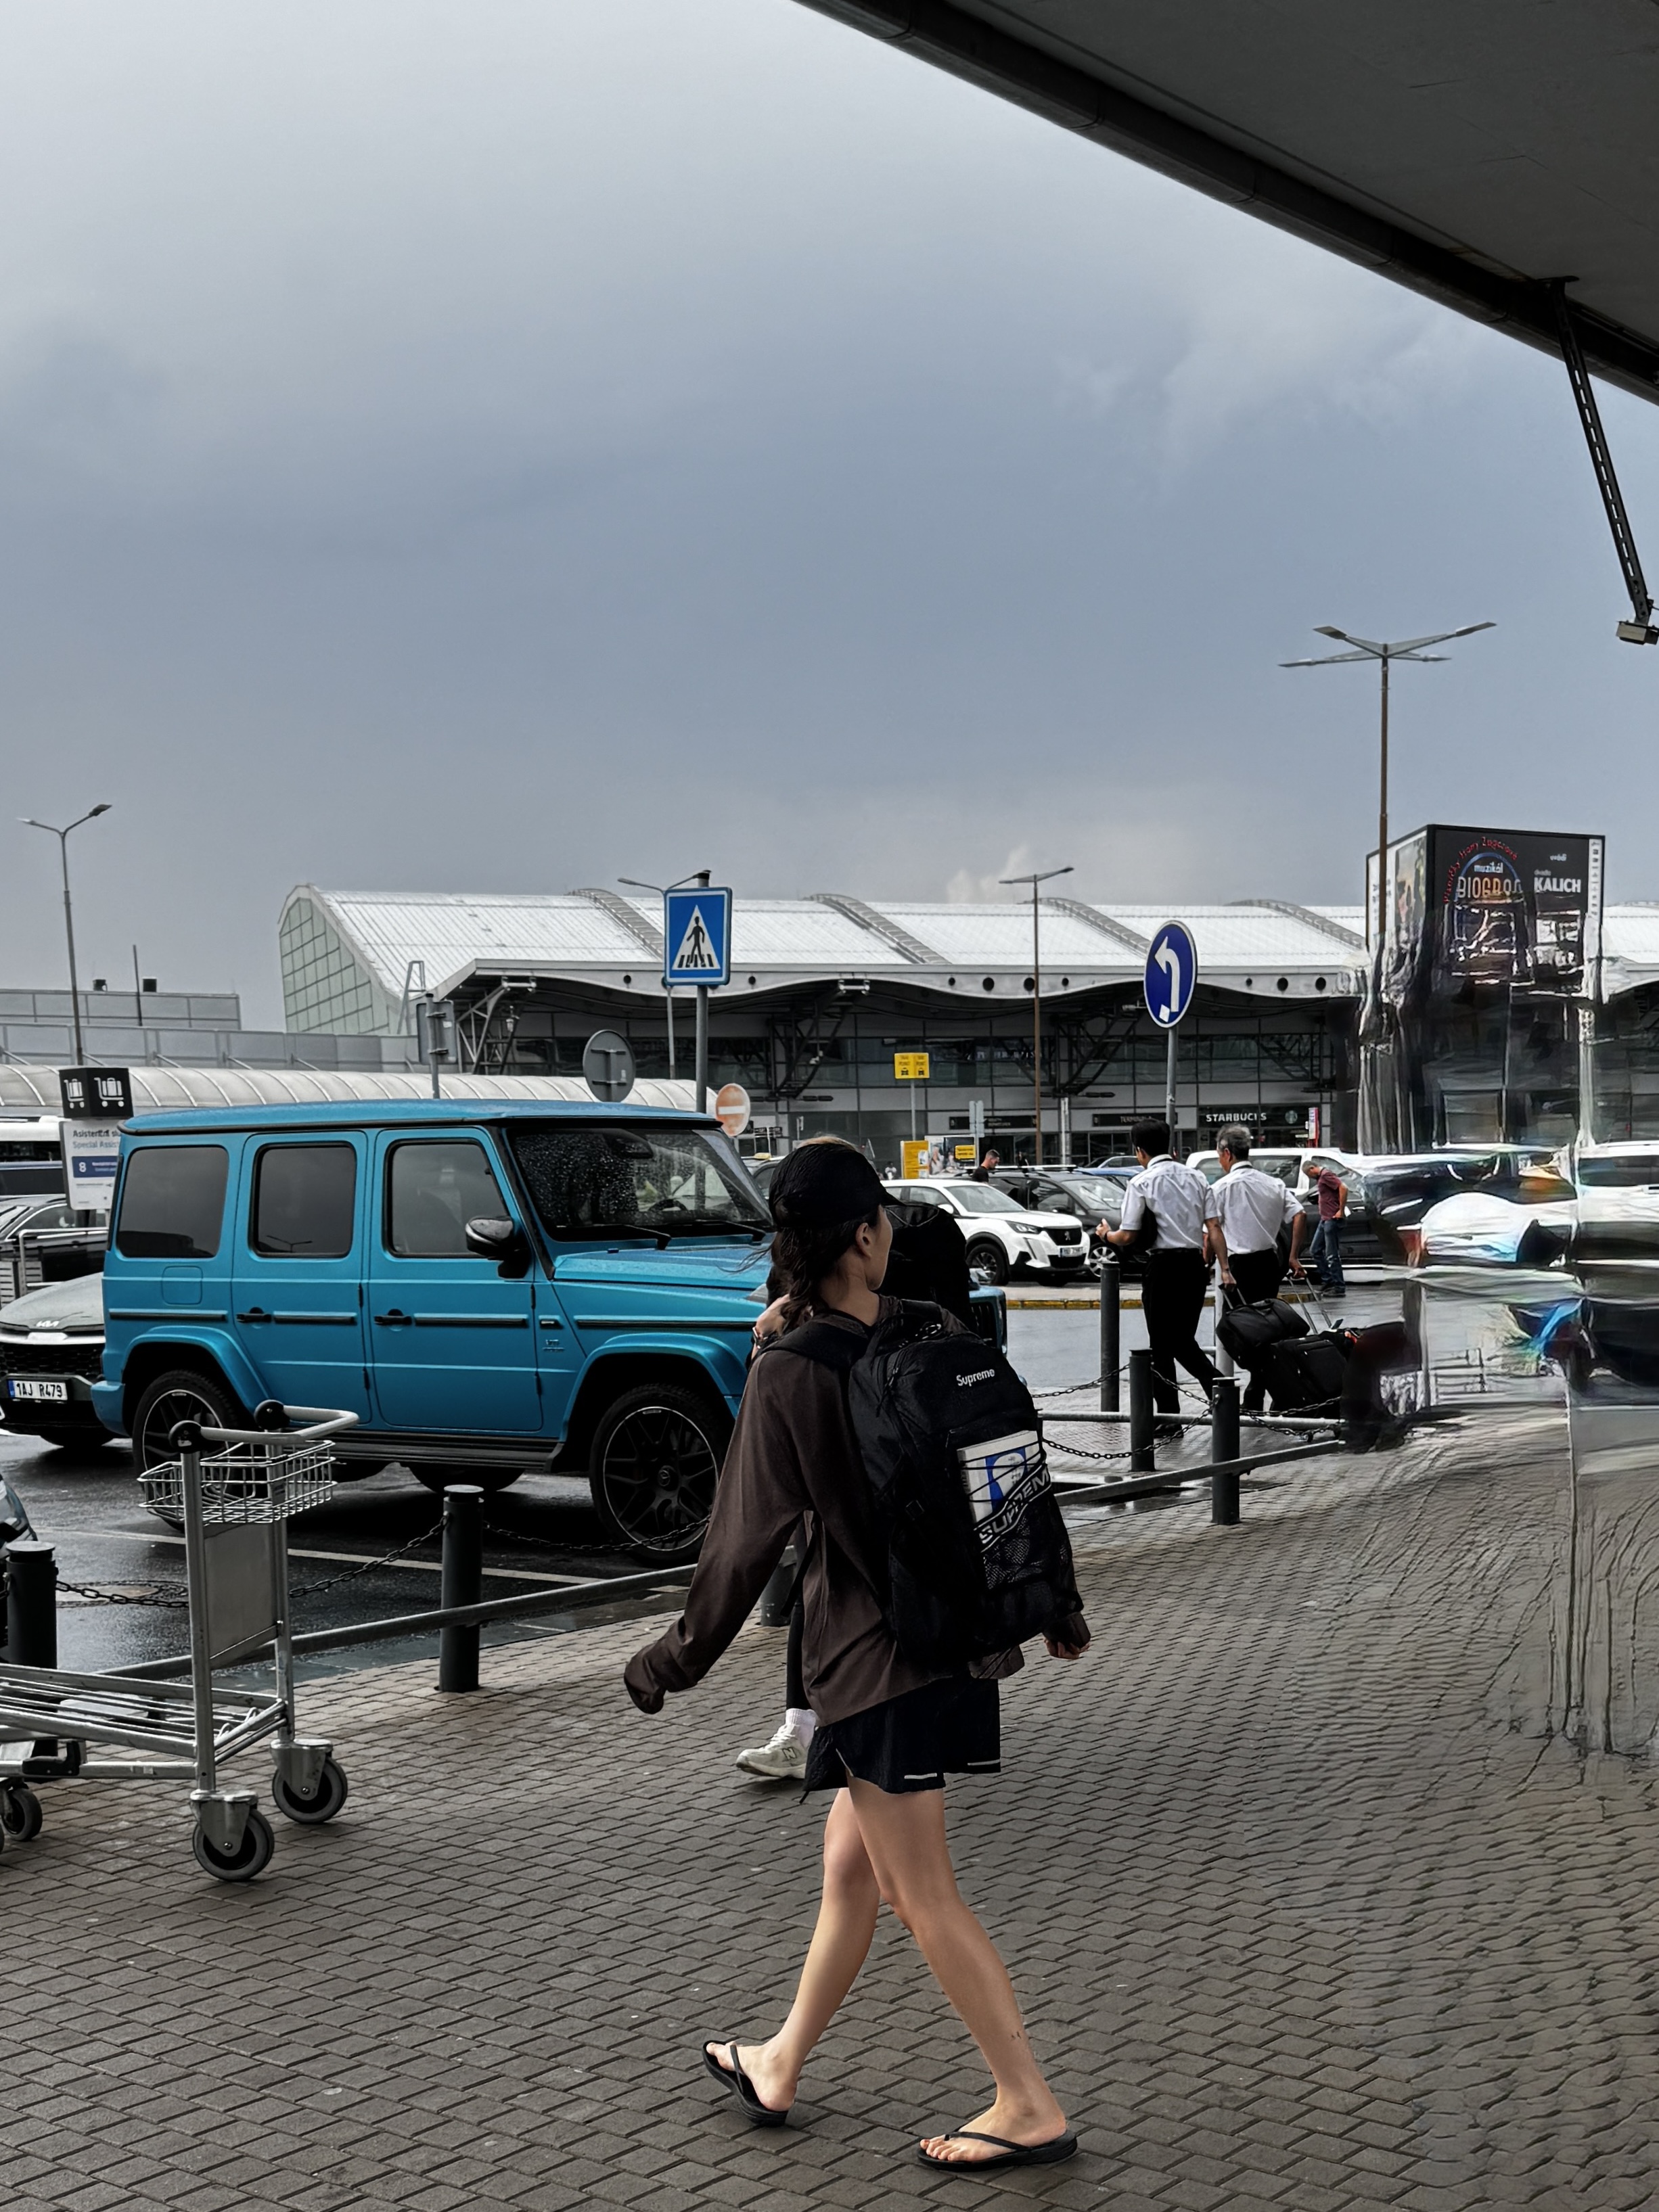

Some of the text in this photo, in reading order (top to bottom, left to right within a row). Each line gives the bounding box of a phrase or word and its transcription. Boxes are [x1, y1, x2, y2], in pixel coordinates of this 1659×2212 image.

[1533, 877, 1582, 894] KALICH
[78, 1161, 87, 1173] 8
[16, 1382, 63, 1398] 1AJ R479
